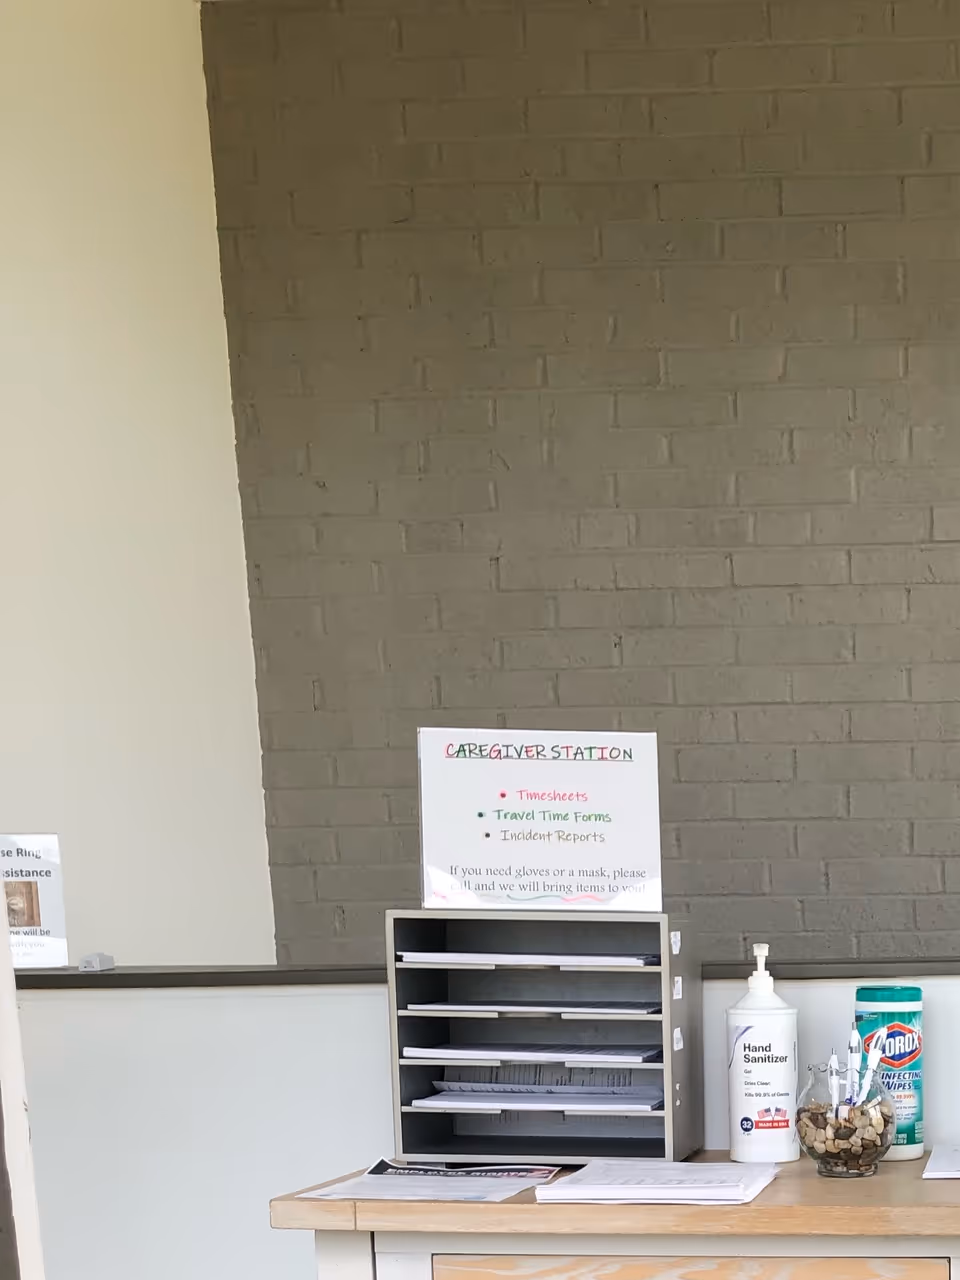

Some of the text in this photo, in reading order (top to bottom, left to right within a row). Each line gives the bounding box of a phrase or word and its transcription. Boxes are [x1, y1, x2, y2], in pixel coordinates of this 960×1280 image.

[445, 743, 633, 761] CAREGIVER STATION
[516, 789, 589, 802] Timesheets
[492, 809, 612, 823] Travel Time Forms
[500, 829, 606, 843] Incident Reports
[16, 847, 42, 860] Ring
[450, 865, 647, 880] If you need gloves or a mask, please
[474, 880, 496, 892] and
[499, 882, 515, 892] we
[518, 881, 540, 892] will
[542, 881, 574, 895] bring
[576, 882, 605, 893] items
[608, 882, 619, 893] to
[22, 928, 38, 936] will
[39, 928, 51, 936] be
[743, 1043, 772, 1053] Hand
[884, 1030, 922, 1058] OROX
[743, 1054, 788, 1064] Sanitizer
[742, 1120, 752, 1129] 32
